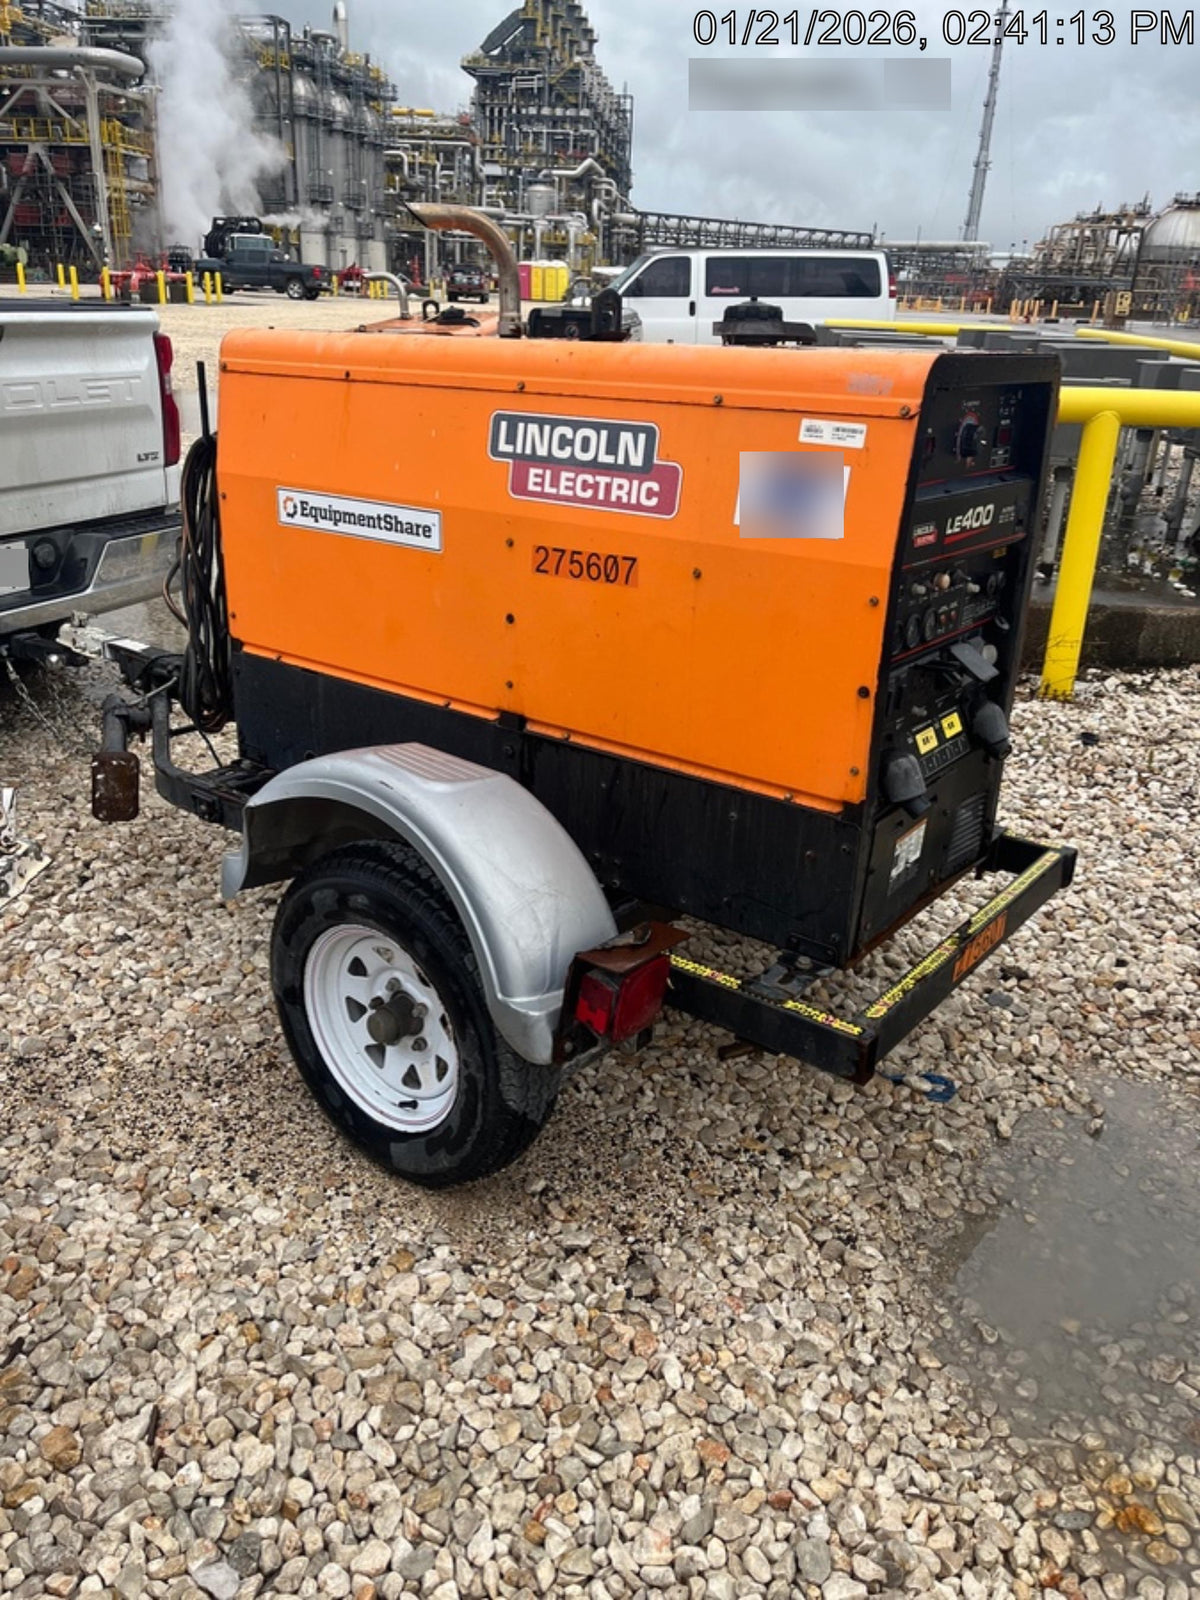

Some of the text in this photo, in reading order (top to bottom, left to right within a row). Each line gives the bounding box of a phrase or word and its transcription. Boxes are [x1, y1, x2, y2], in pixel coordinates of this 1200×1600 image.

[497, 420, 647, 468] LINCOLN
[527, 467, 661, 508] ELECTRIC
[299, 500, 433, 539] EquipmentShare
[945, 503, 995, 536] LE400
[534, 545, 638, 586] 275607
